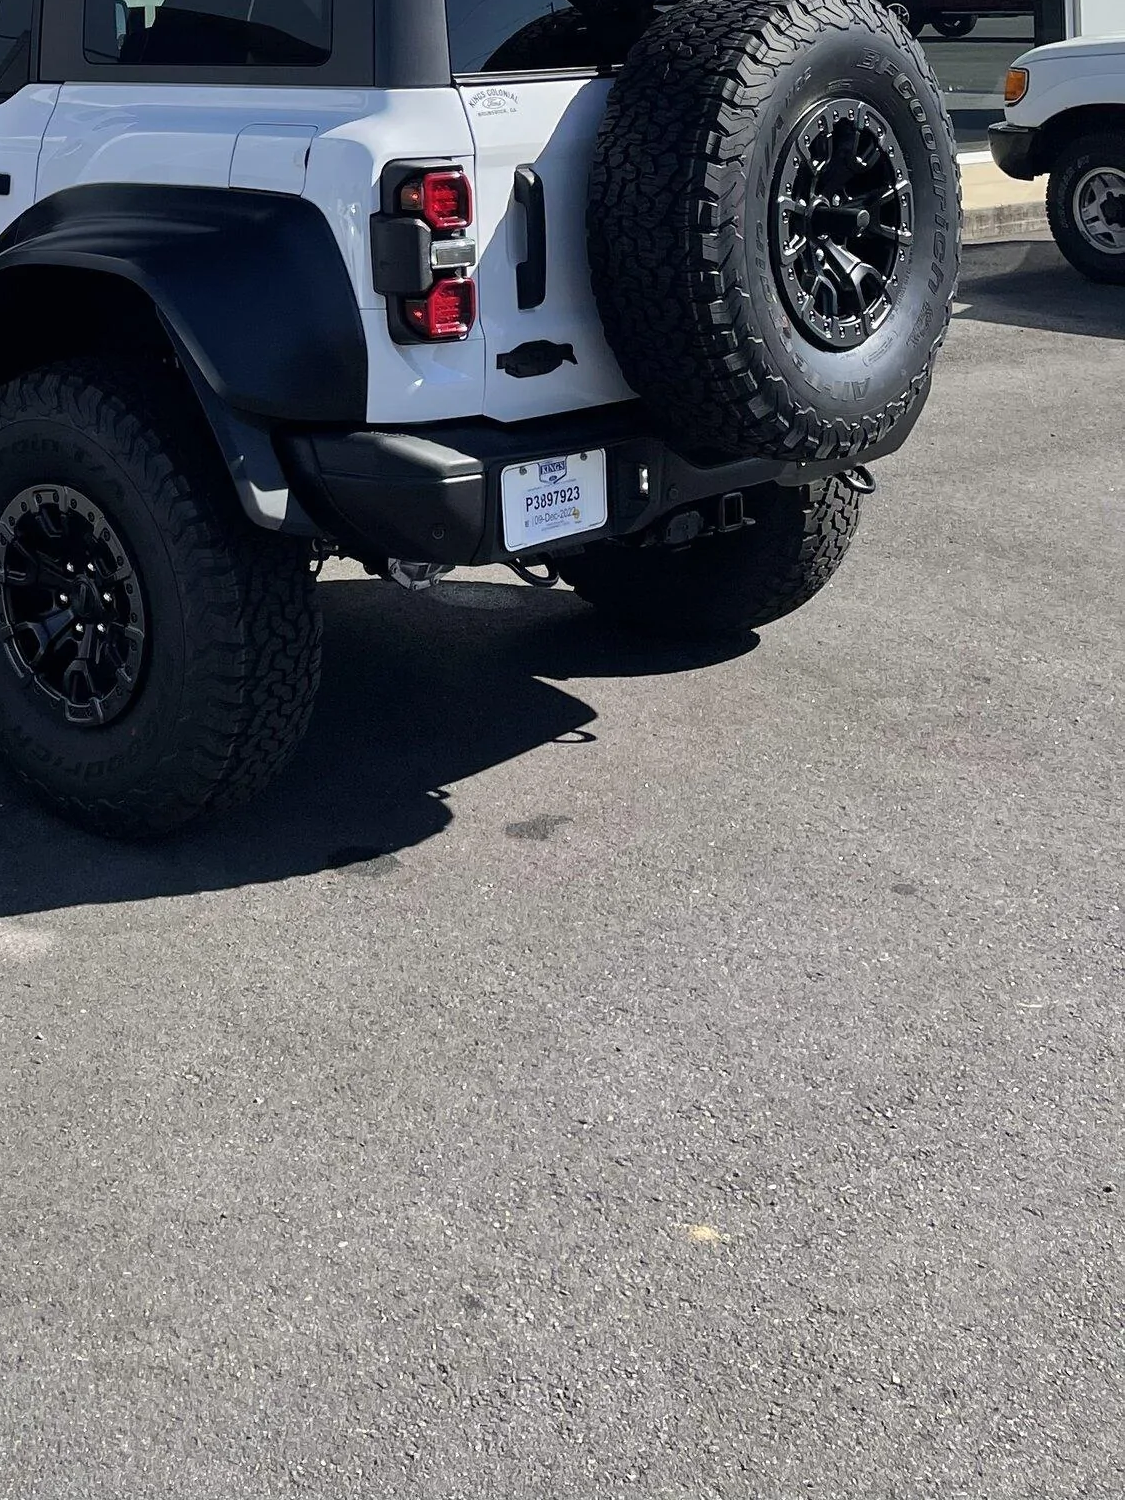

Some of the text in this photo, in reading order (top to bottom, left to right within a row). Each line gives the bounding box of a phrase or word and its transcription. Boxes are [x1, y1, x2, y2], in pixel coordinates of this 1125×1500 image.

[486, 88, 519, 104] COLONIAL
[856, 47, 950, 296] BFGoodrich
[525, 485, 580, 512] P3897923
